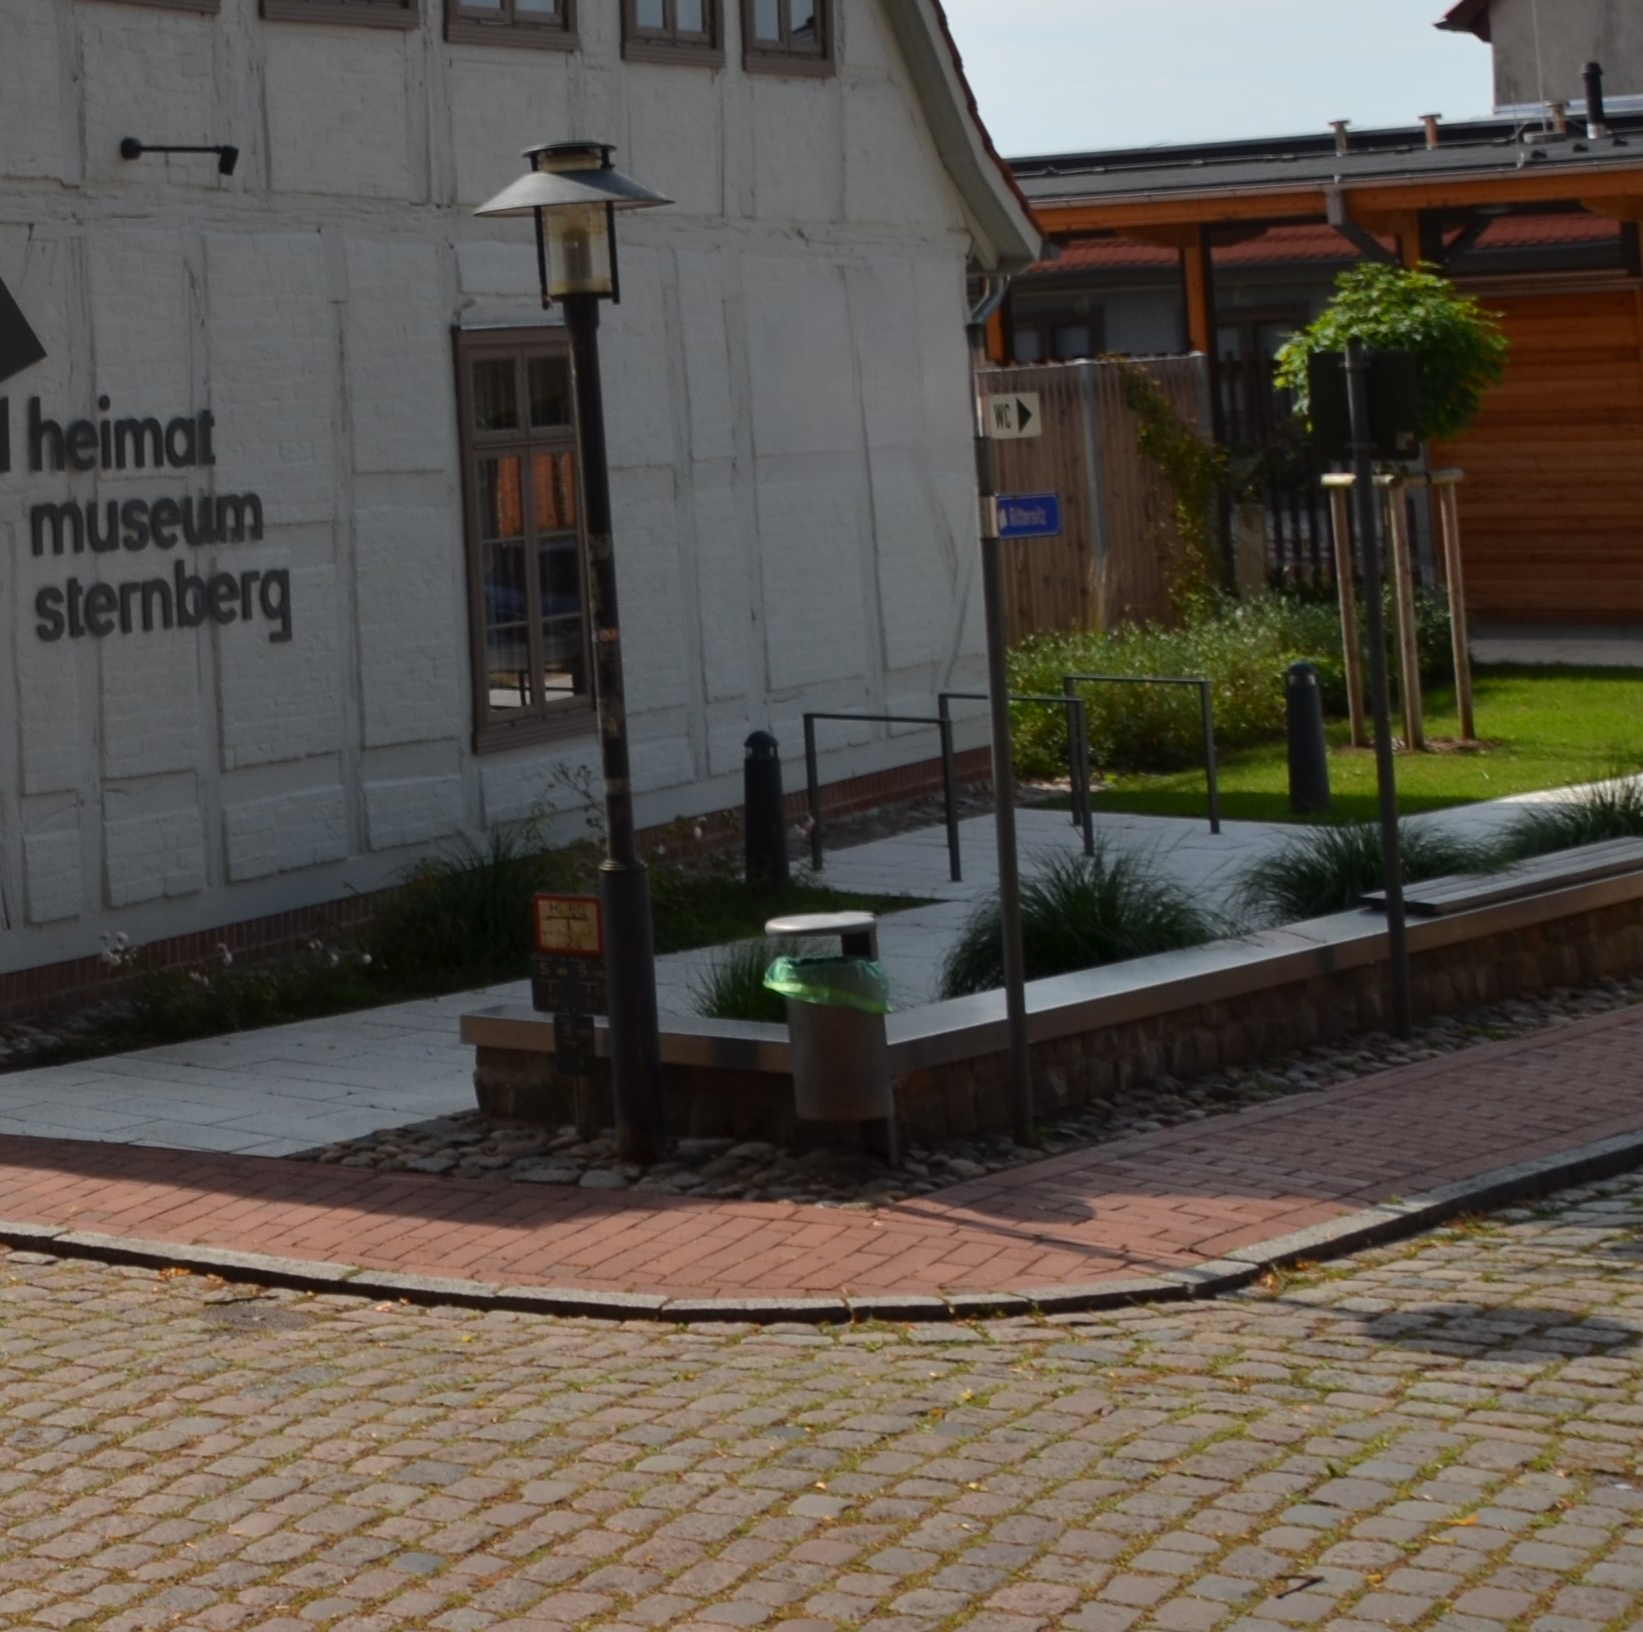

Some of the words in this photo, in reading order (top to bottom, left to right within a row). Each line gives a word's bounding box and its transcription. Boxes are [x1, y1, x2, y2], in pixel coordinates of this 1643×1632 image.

[27, 395, 216, 473] heimat
[993, 403, 1012, 429] WC
[31, 492, 263, 556] museum
[35, 560, 293, 642] sternberg
